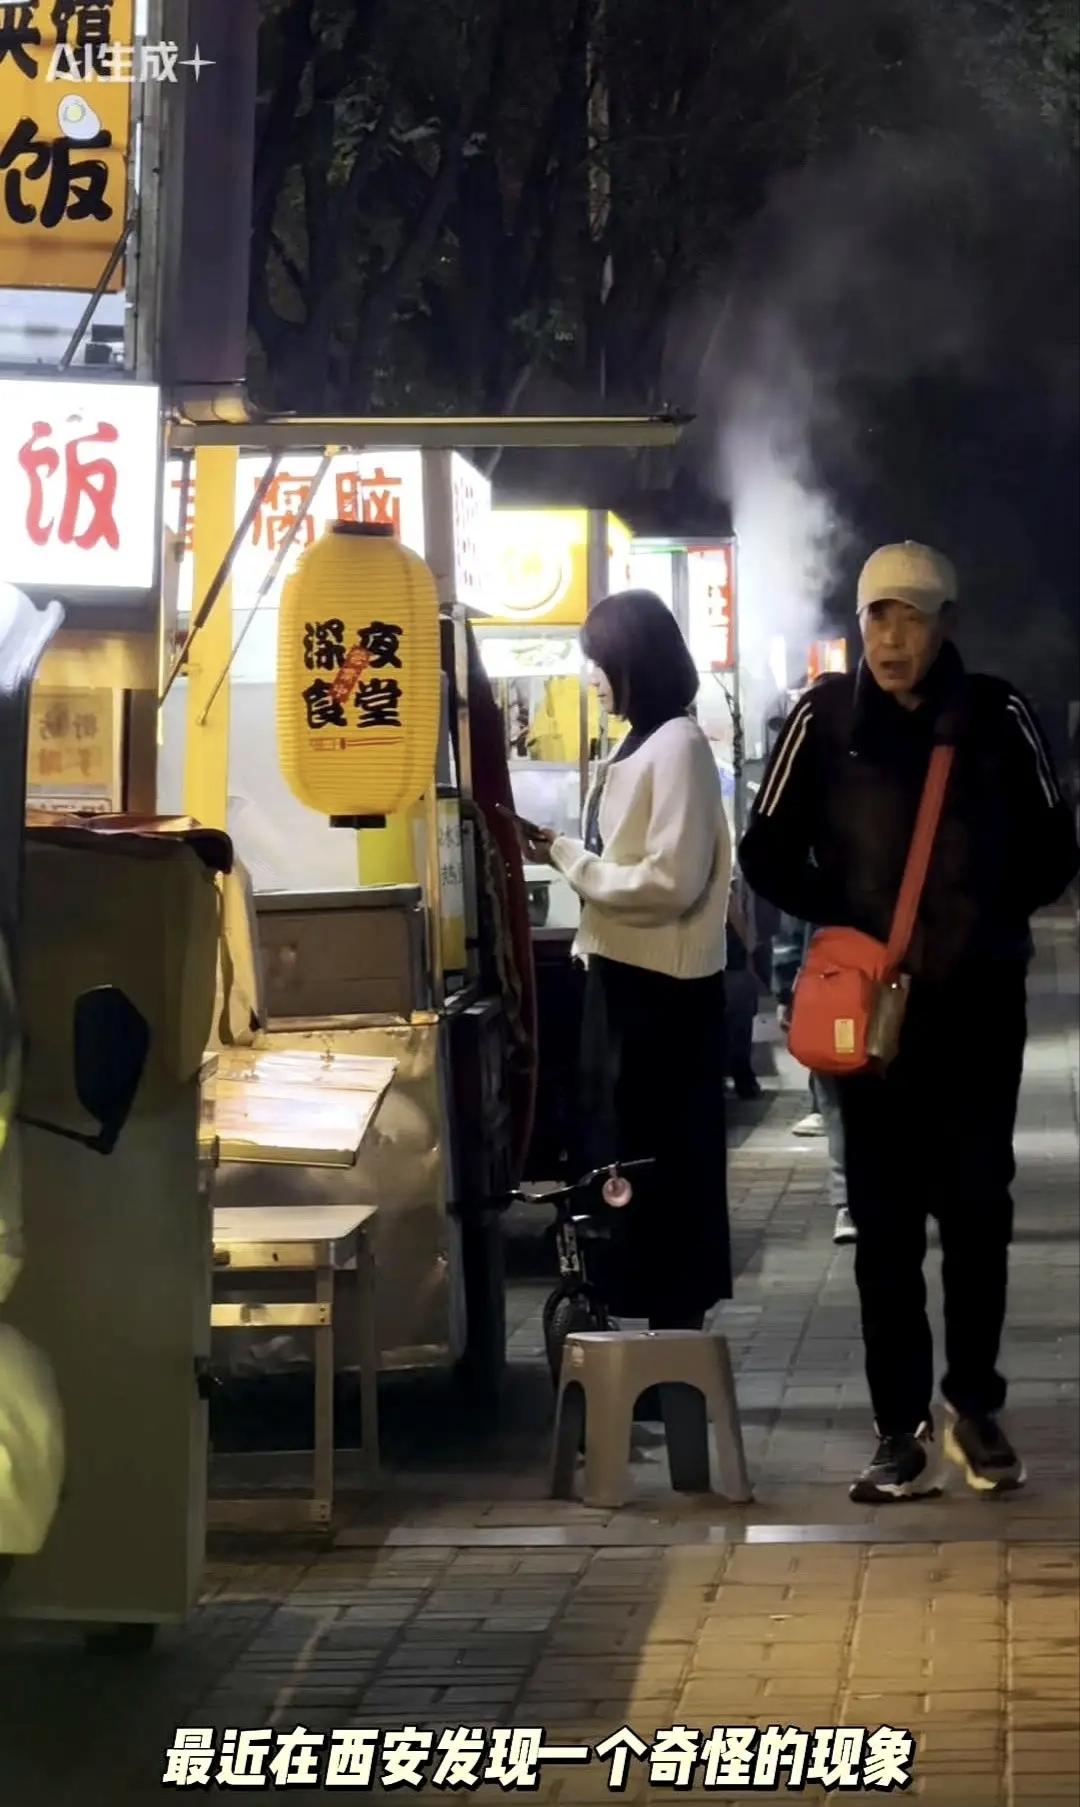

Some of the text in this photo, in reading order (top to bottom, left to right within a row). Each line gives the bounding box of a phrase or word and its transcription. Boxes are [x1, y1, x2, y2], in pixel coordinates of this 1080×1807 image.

[0, 116, 113, 228] 饭
[18, 420, 120, 551] 饭
[303, 618, 403, 670] 深夜
[302, 677, 403, 729] 食堂
